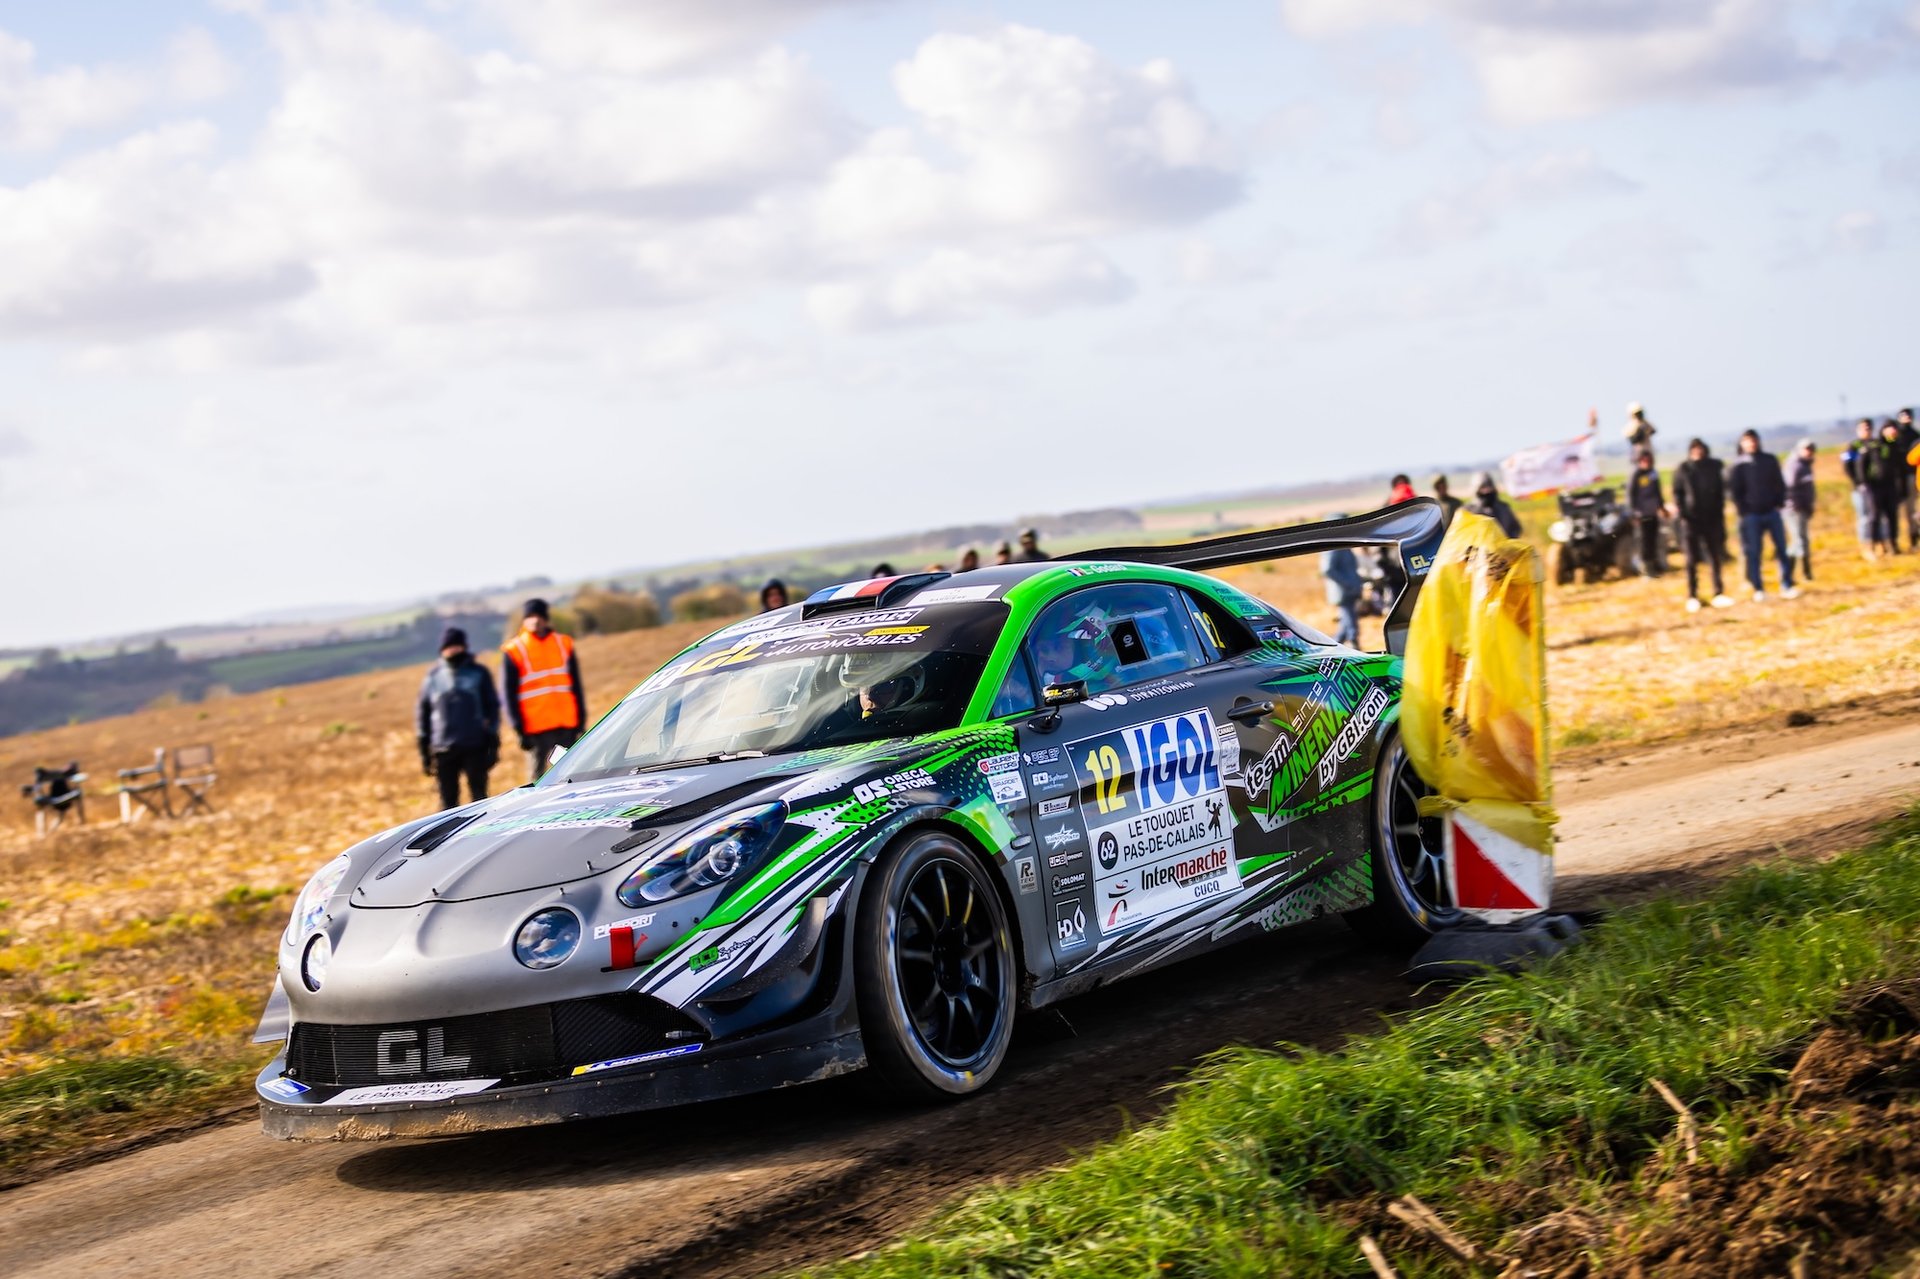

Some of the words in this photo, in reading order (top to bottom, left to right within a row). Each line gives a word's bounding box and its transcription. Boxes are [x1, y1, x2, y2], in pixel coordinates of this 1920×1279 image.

[832, 611, 913, 627] CANAL+
[770, 633, 923, 656] AUTOMOBILES
[1134, 713, 1220, 810] IGOL
[1246, 736, 1290, 796] team
[1271, 694, 1350, 815] MINERVA
[884, 768, 930, 785] ORECA
[892, 776, 937, 793] STORE
[1085, 745, 1127, 815] 12
[1128, 820, 1144, 839] LE
[1144, 804, 1195, 833] TOUQUET
[1101, 839, 1117, 861] 62
[1124, 822, 1206, 862] PAS-DE-CALAIS
[1194, 880, 1221, 898] CUCQ
[377, 1026, 472, 1076] GL
